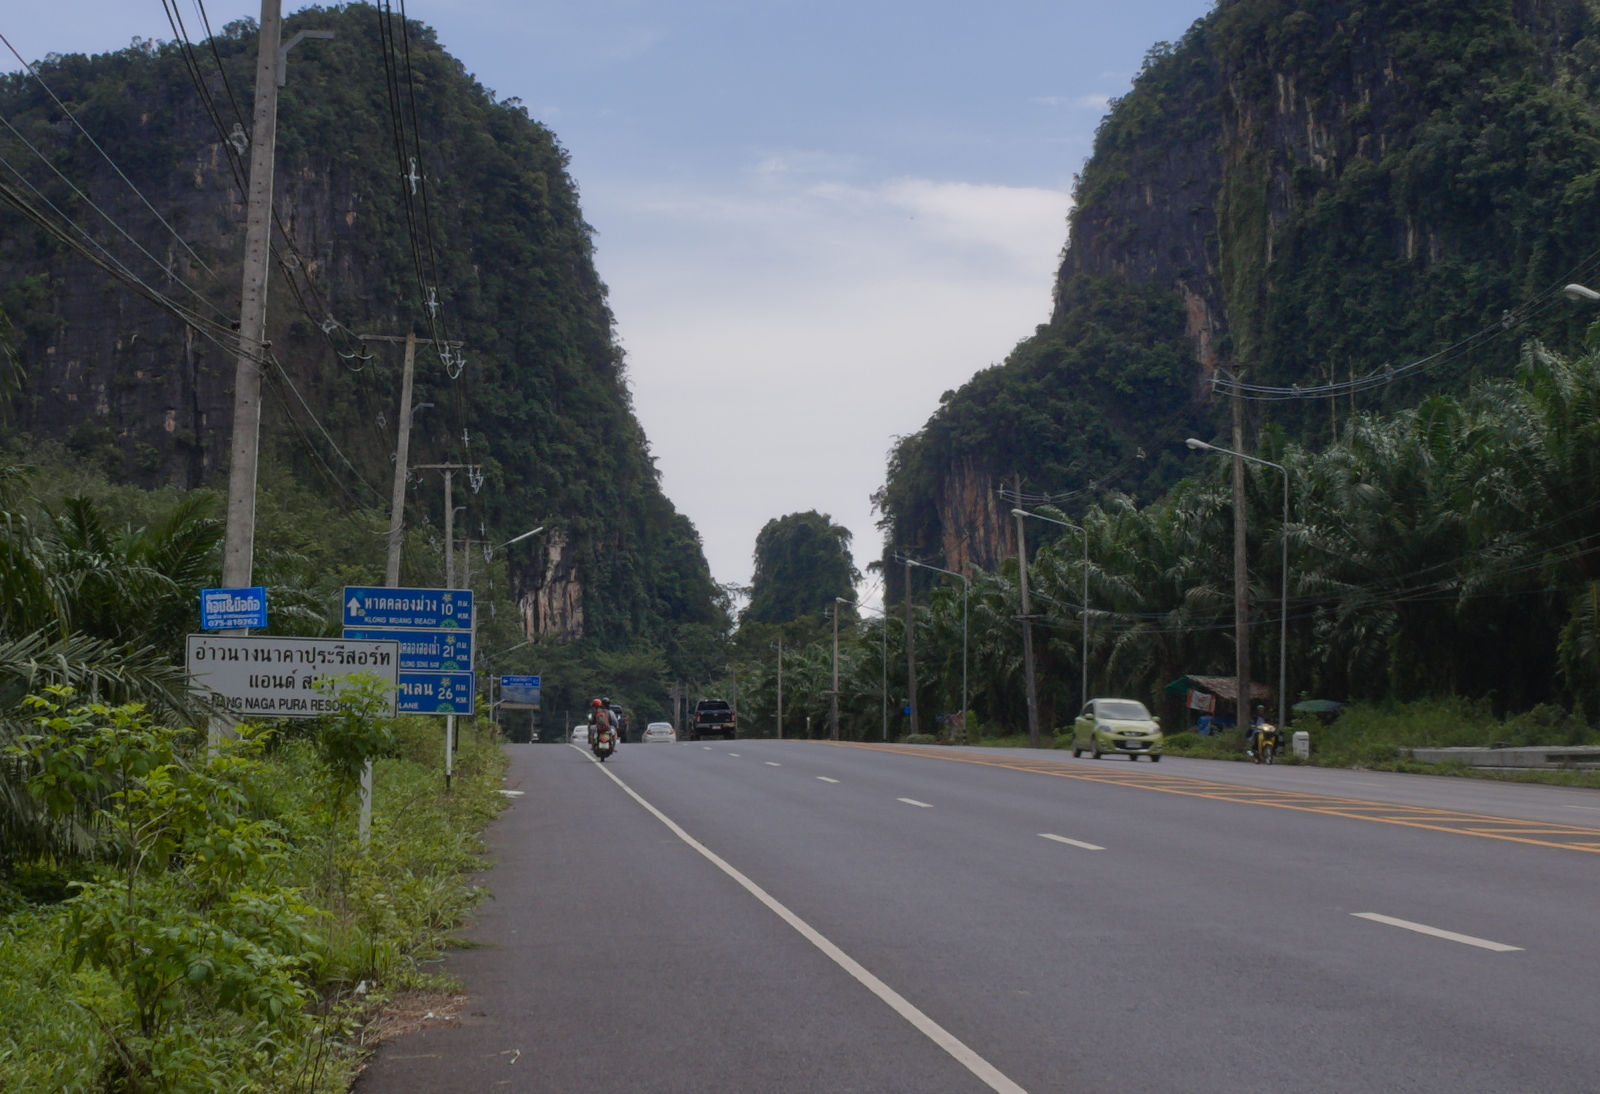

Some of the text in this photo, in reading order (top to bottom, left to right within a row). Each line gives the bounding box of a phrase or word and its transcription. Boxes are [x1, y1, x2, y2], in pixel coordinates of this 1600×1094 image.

[364, 595, 453, 615] หาดคลองม่วง 10
[196, 641, 390, 671] อ่าวนางนาคาปุระรีสอร์ท
[442, 645, 454, 658] 21
[249, 669, 296, 690] แอนด์
[437, 687, 453, 700] 26
[245, 697, 275, 710] NAGA
[279, 698, 308, 712] PURA
